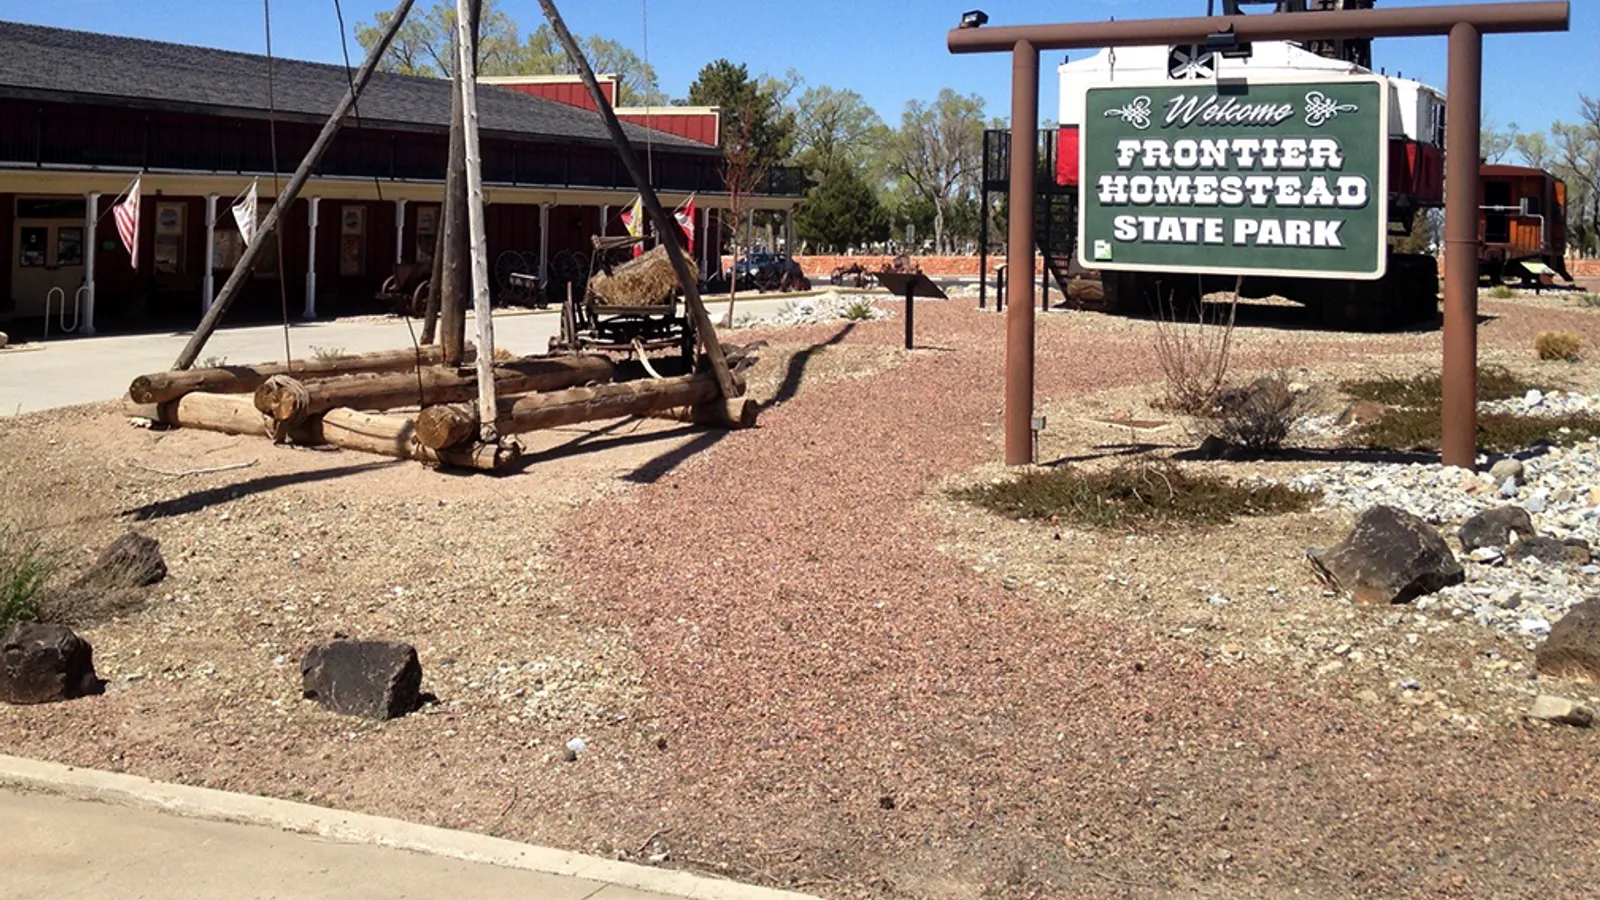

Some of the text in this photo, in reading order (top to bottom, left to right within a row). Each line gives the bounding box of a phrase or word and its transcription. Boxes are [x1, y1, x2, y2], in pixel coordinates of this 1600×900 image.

[1163, 94, 1294, 125] Welcome
[1116, 138, 1343, 168] FRONTIER
[1098, 175, 1368, 206] HOMESTEAD
[1113, 215, 1343, 246] STATE PARK
